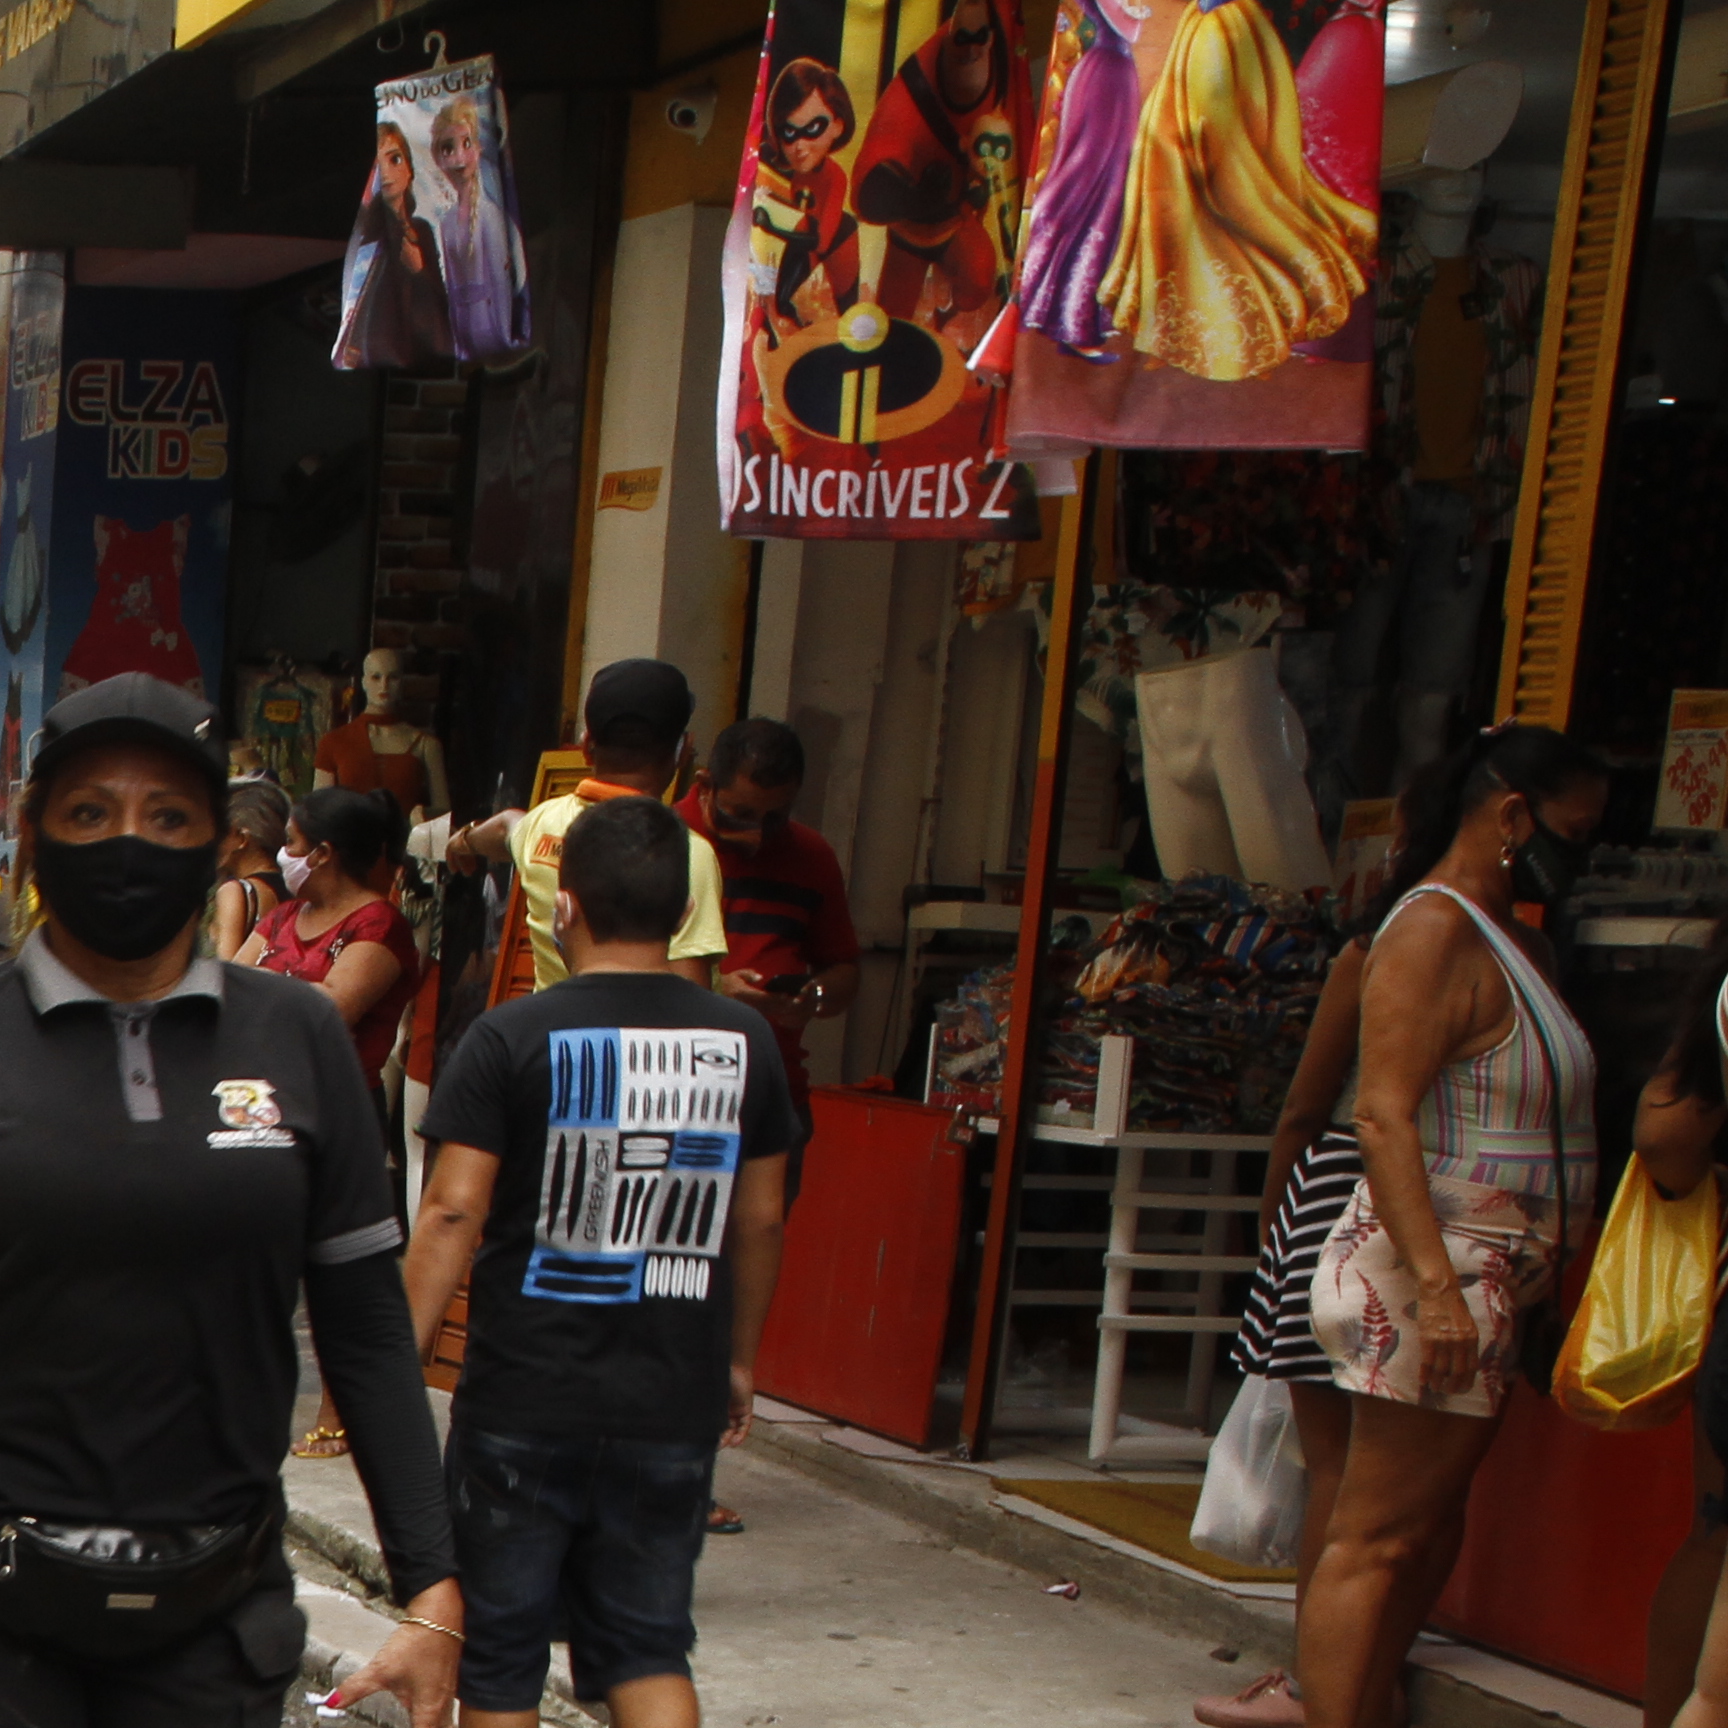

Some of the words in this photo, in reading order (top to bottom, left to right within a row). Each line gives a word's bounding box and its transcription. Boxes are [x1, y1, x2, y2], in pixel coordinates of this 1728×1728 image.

[66, 358, 229, 426] ELZA
[107, 423, 230, 481] KIDS
[769, 453, 974, 518] INCRÍVEIS
[978, 448, 1018, 518] 2
